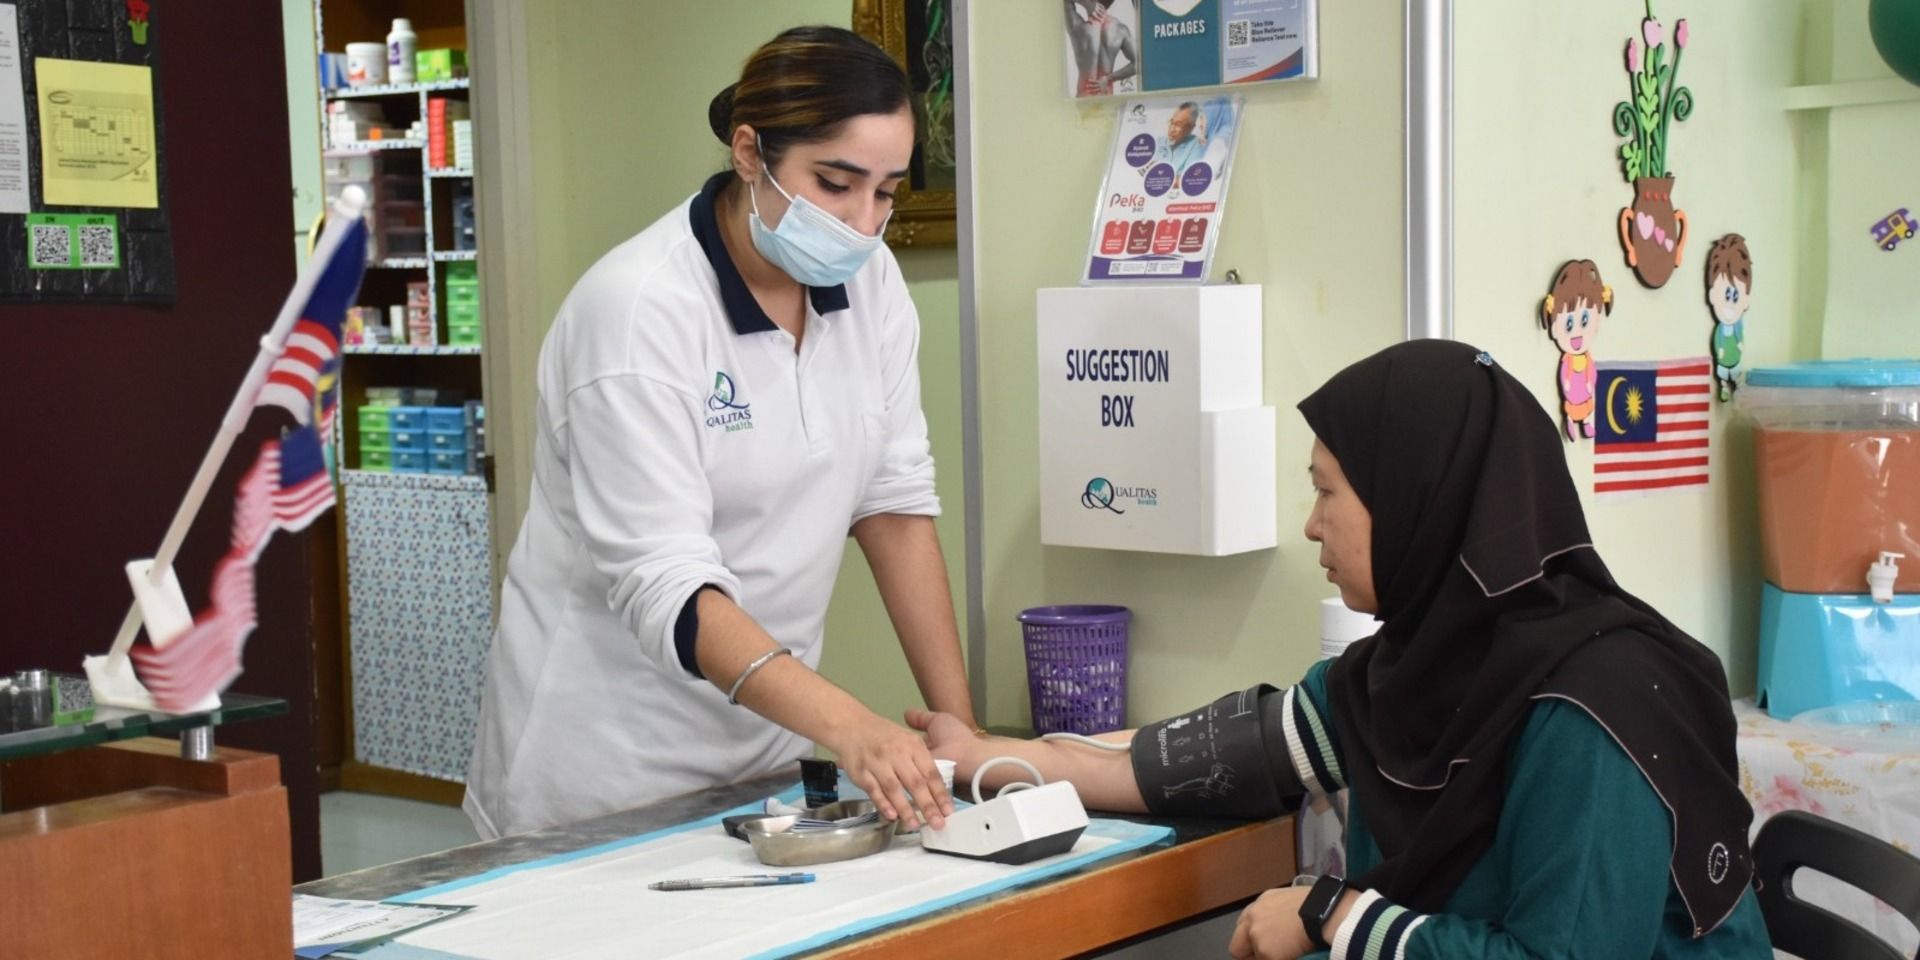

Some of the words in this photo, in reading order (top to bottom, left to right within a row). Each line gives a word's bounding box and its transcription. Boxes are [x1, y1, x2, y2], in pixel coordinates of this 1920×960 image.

[1154, 20, 1206, 38] PACKAGES
[1109, 193, 1146, 208] PeKa
[1066, 349, 1169, 382] SUGGESTION
[706, 408, 752, 427] QALITAS
[1101, 395, 1134, 427] BOX
[1157, 727, 1170, 767] microlife
